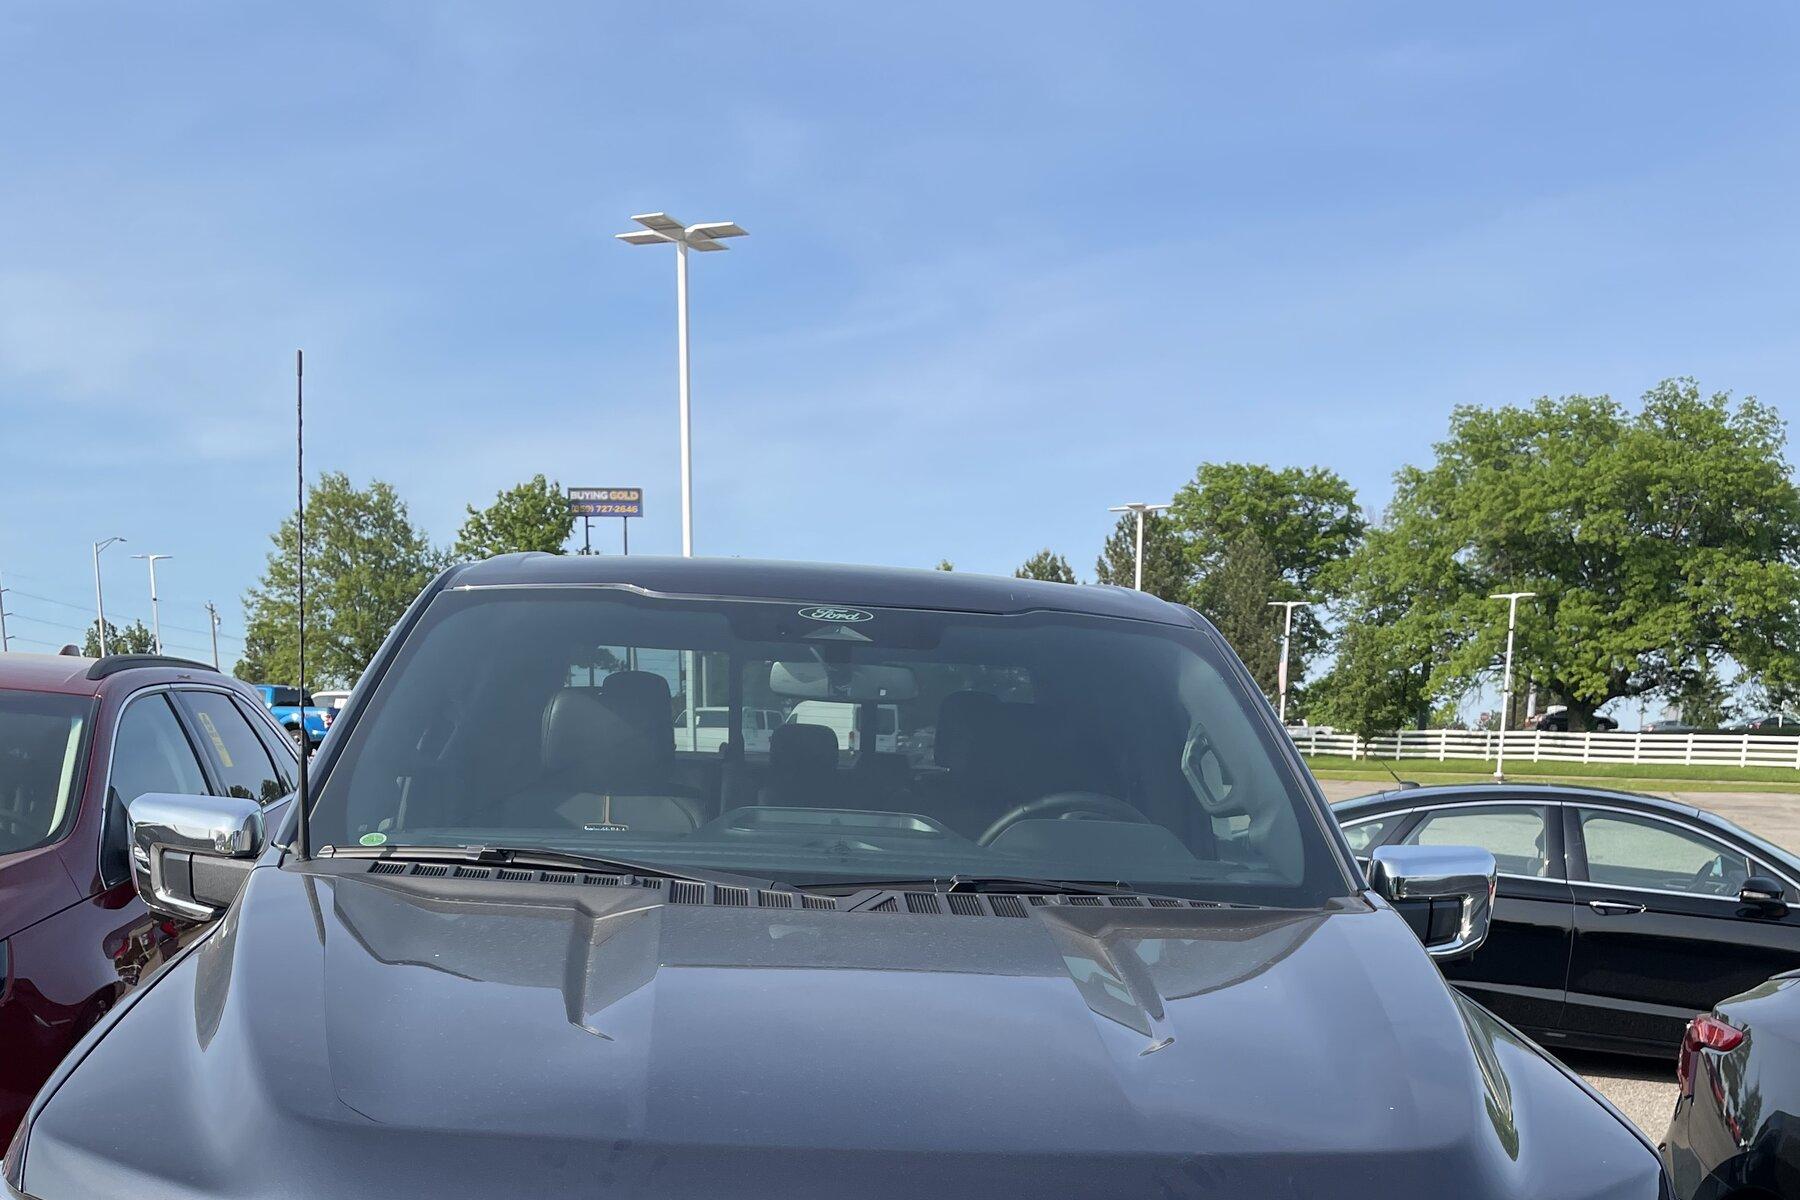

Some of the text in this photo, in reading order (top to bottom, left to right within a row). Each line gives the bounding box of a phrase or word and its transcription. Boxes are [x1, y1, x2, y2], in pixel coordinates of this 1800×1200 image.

[570, 491, 638, 500] BUYING GOLD
[811, 608, 859, 620] Ford
